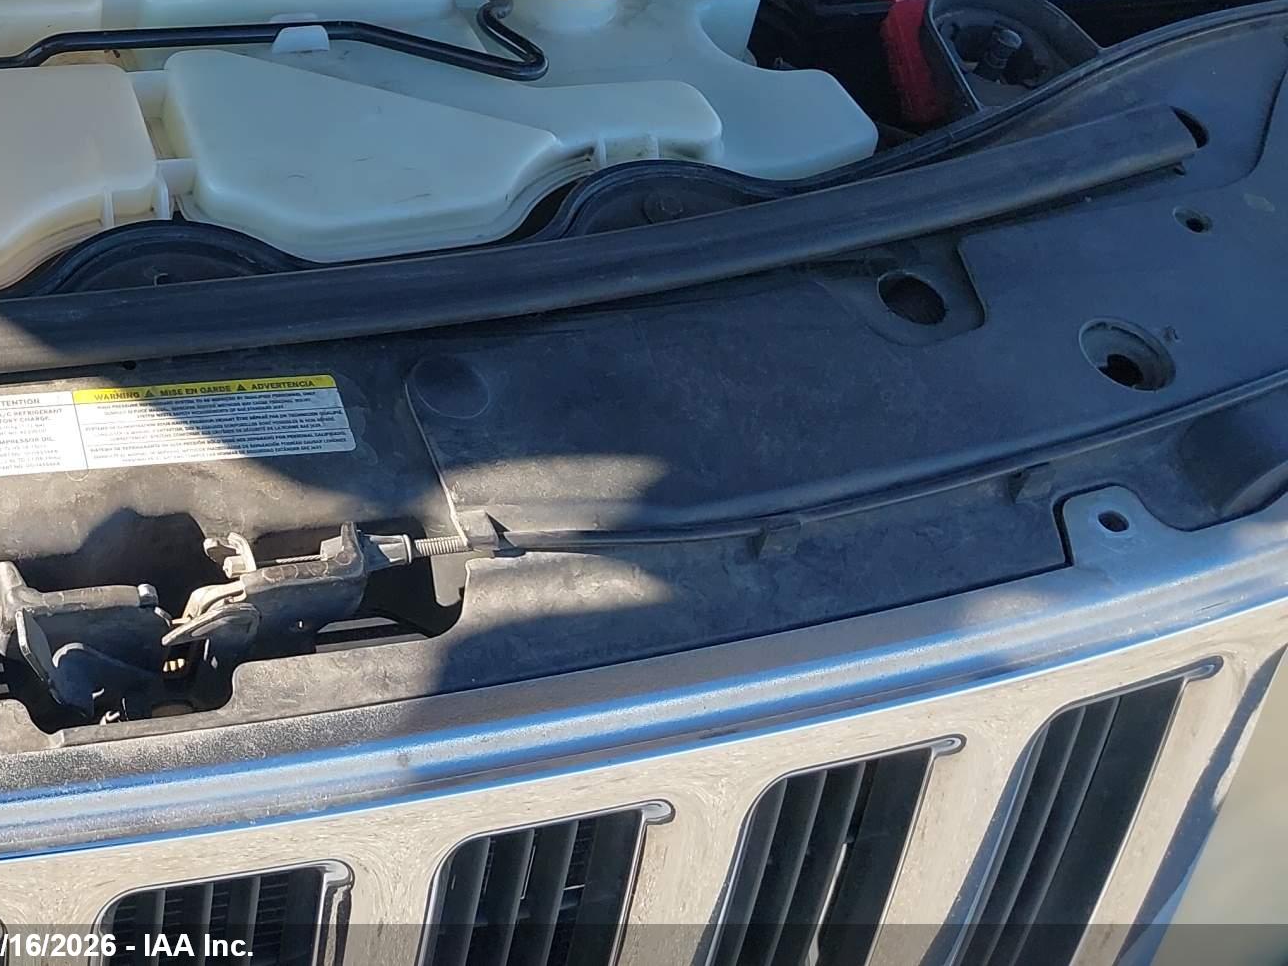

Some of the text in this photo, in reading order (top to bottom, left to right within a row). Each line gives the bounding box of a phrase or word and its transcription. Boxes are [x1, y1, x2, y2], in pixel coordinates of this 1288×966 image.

[94, 391, 140, 401] WARNING
[160, 388, 183, 396] MISE
[185, 387, 198, 395] EN
[251, 380, 315, 390] ADVERTENCIA
